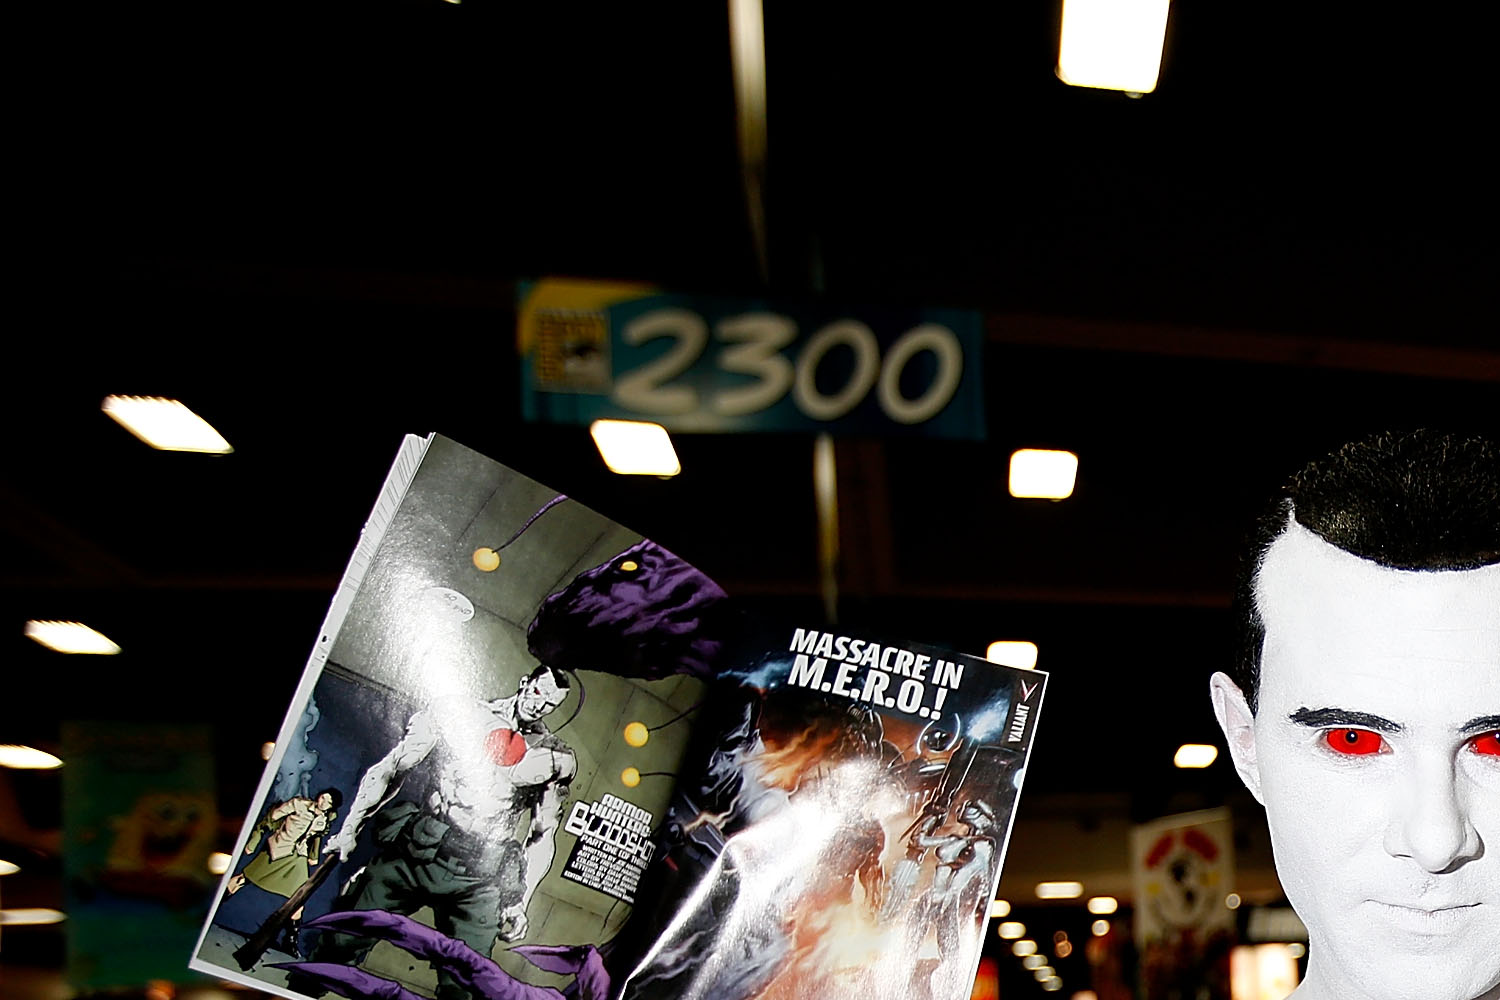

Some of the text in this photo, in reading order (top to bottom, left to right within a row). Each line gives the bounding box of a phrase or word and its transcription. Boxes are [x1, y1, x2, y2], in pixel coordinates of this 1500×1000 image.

[614, 308, 964, 425] 2300
[789, 628, 965, 690] MASSACRE IN
[787, 654, 949, 721] M.E.R.O.!
[1008, 702, 1030, 742] VALIANT
[602, 793, 653, 826] ARMOR
[580, 834, 603, 848] PART
[603, 843, 618, 855] ONE
